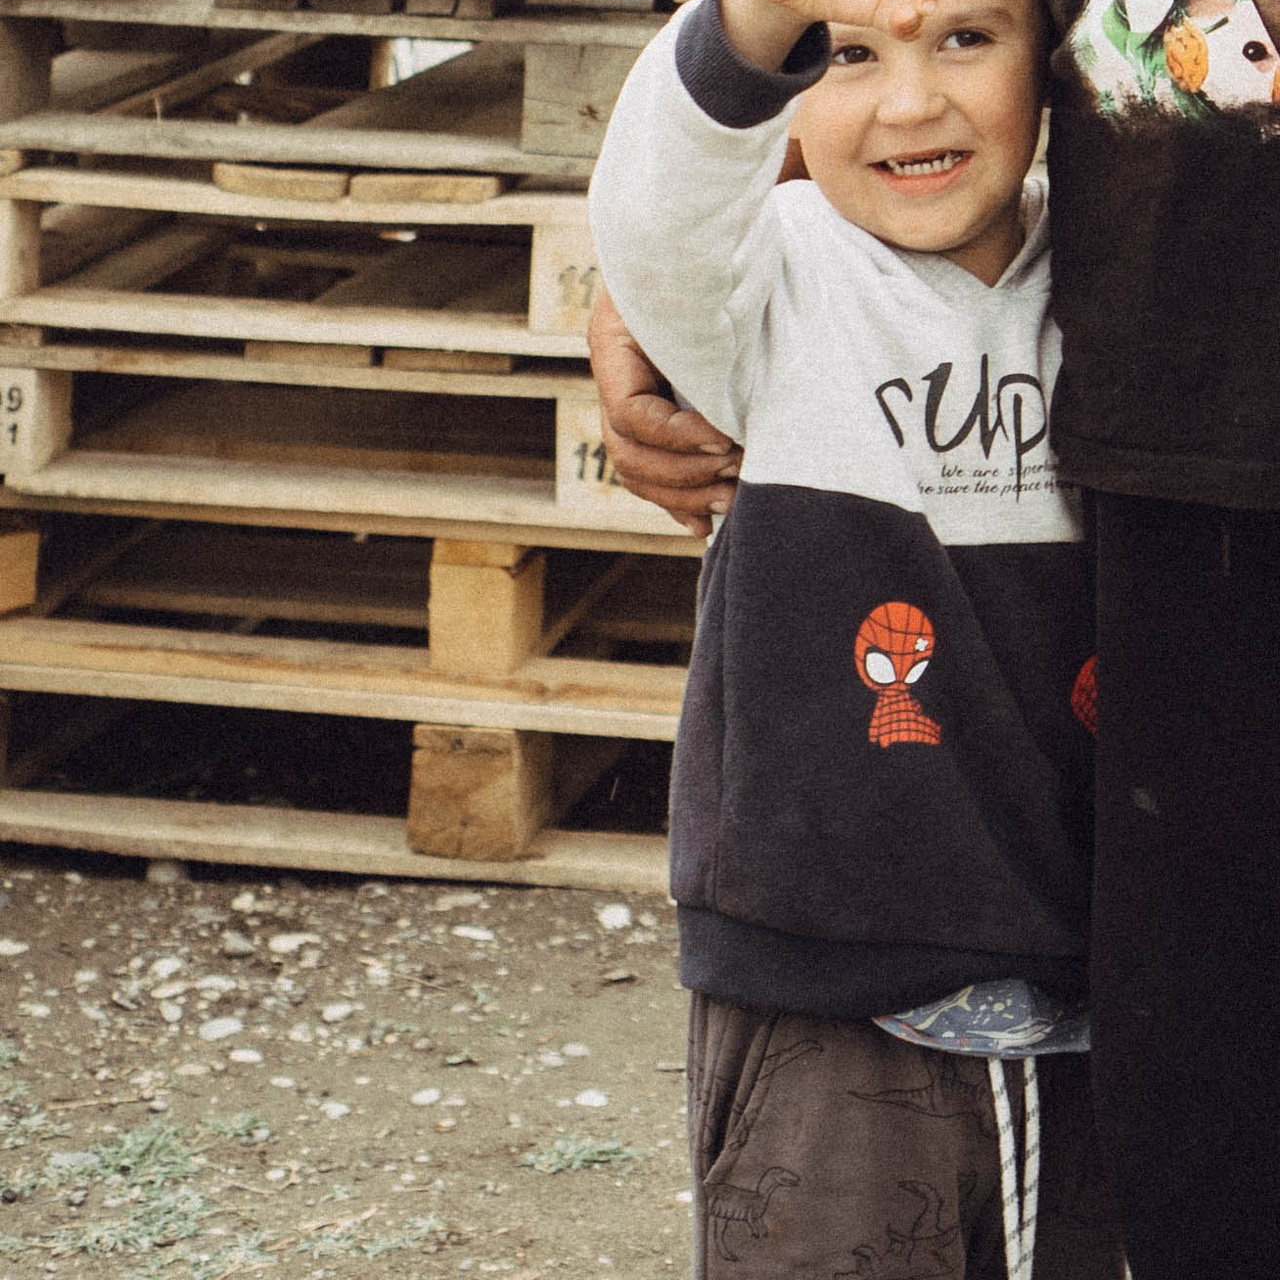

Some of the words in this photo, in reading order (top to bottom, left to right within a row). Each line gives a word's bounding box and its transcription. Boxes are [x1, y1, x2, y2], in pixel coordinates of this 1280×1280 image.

[941, 464, 962, 478] We
[973, 468, 998, 478] are
[973, 481, 998, 495] the
